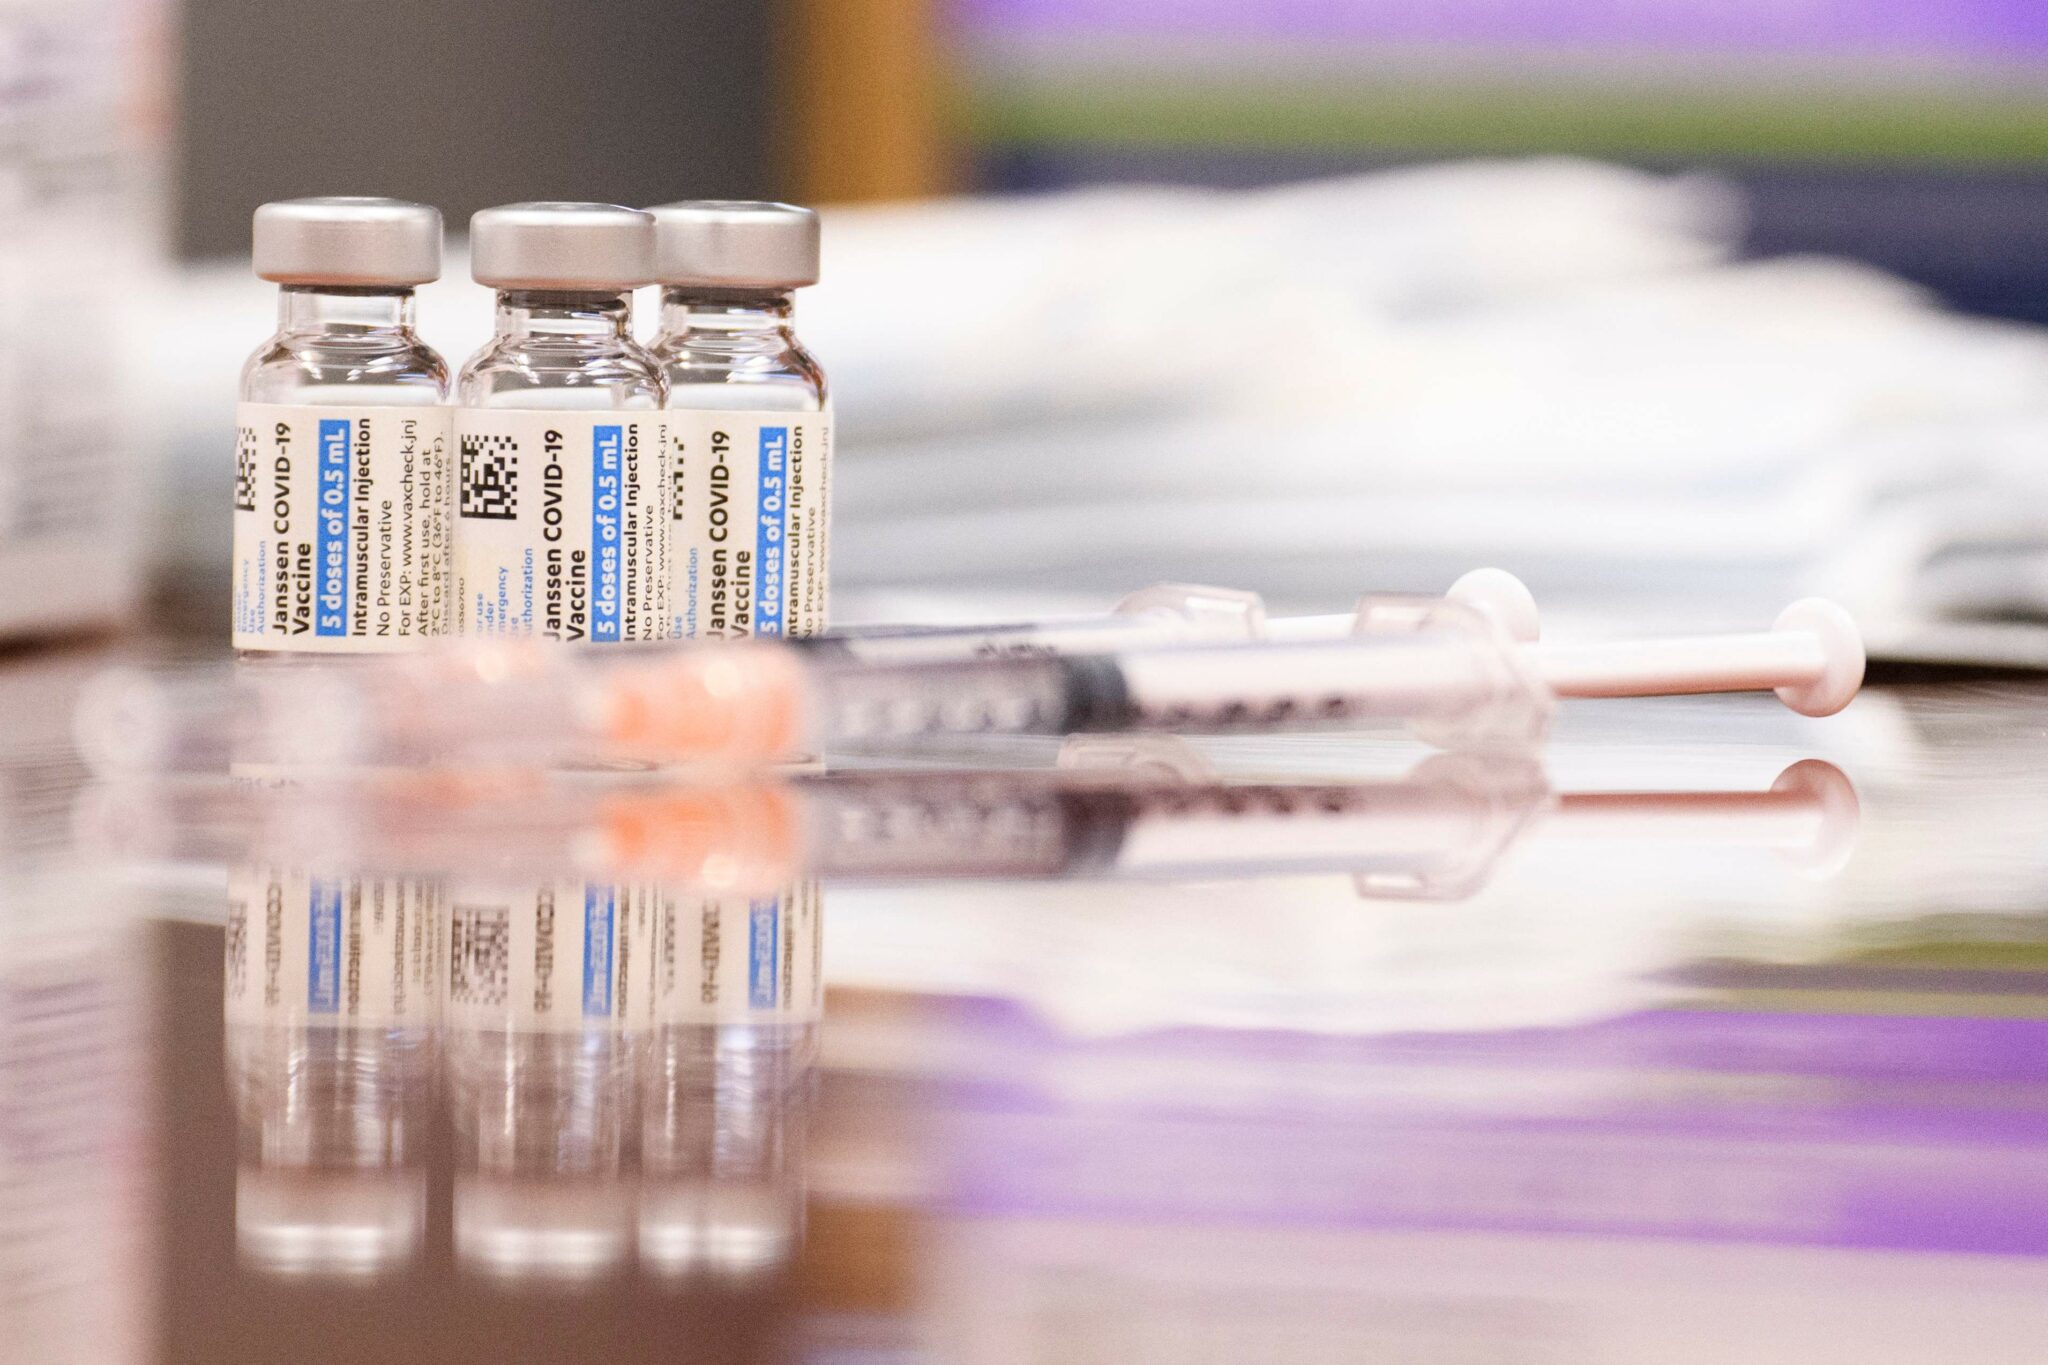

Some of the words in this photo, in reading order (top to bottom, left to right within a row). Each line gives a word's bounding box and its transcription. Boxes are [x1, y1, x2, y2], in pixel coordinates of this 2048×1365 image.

[325, 428, 345, 464] mL
[354, 418, 373, 501] Injection
[421, 449, 431, 466] at
[600, 433, 617, 470] mL
[625, 423, 640, 507] Injection
[765, 435, 783, 471] mL
[274, 423, 290, 534] COVID-19
[544, 430, 563, 542] COVID-19
[709, 431, 729, 543] COVID-19
[790, 426, 803, 508] Injection
[325, 470, 344, 505] 0.5
[400, 419, 417, 567] www.vaxcheck.jnj
[420, 471, 431, 509] hold
[434, 485, 442, 503] to
[598, 476, 617, 511] 0.5
[658, 424, 667, 570] www.vaxcheck.jnj
[763, 477, 781, 512] 0.5
[322, 508, 343, 536] of
[421, 514, 431, 548] use,
[596, 514, 617, 541] of
[760, 515, 780, 542] of
[378, 500, 392, 606] Preservative
[442, 525, 450, 567] after
[644, 505, 653, 611] Preservative
[804, 507, 816, 613] Preservative
[320, 541, 343, 610] doses
[352, 506, 370, 637] Intramuscular
[418, 553, 430, 588] first
[432, 553, 441, 581] 8°C
[595, 547, 617, 616] doses
[624, 512, 637, 642] Intramuscular
[759, 546, 779, 616] doses
[257, 540, 266, 635] Authorization
[273, 542, 289, 634] Janssen
[292, 543, 310, 635] Vaccine
[400, 570, 412, 605] EXP:
[432, 586, 441, 604] to
[497, 567, 508, 634] mergency
[543, 549, 561, 642] Janssen
[566, 550, 585, 642] Vaccine
[685, 548, 698, 640] Authorization
[706, 549, 726, 640] Janssen
[731, 551, 751, 639] Vaccine
[322, 615, 342, 629] 5
[377, 612, 390, 637] No
[399, 610, 411, 636] For
[417, 592, 429, 636] After
[431, 609, 440, 636] 2°C
[485, 601, 494, 634] nder
[597, 621, 616, 634] 5
[643, 616, 653, 641] No
[657, 614, 665, 640] For
[673, 616, 682, 639] Use
[760, 621, 777, 634] 5
